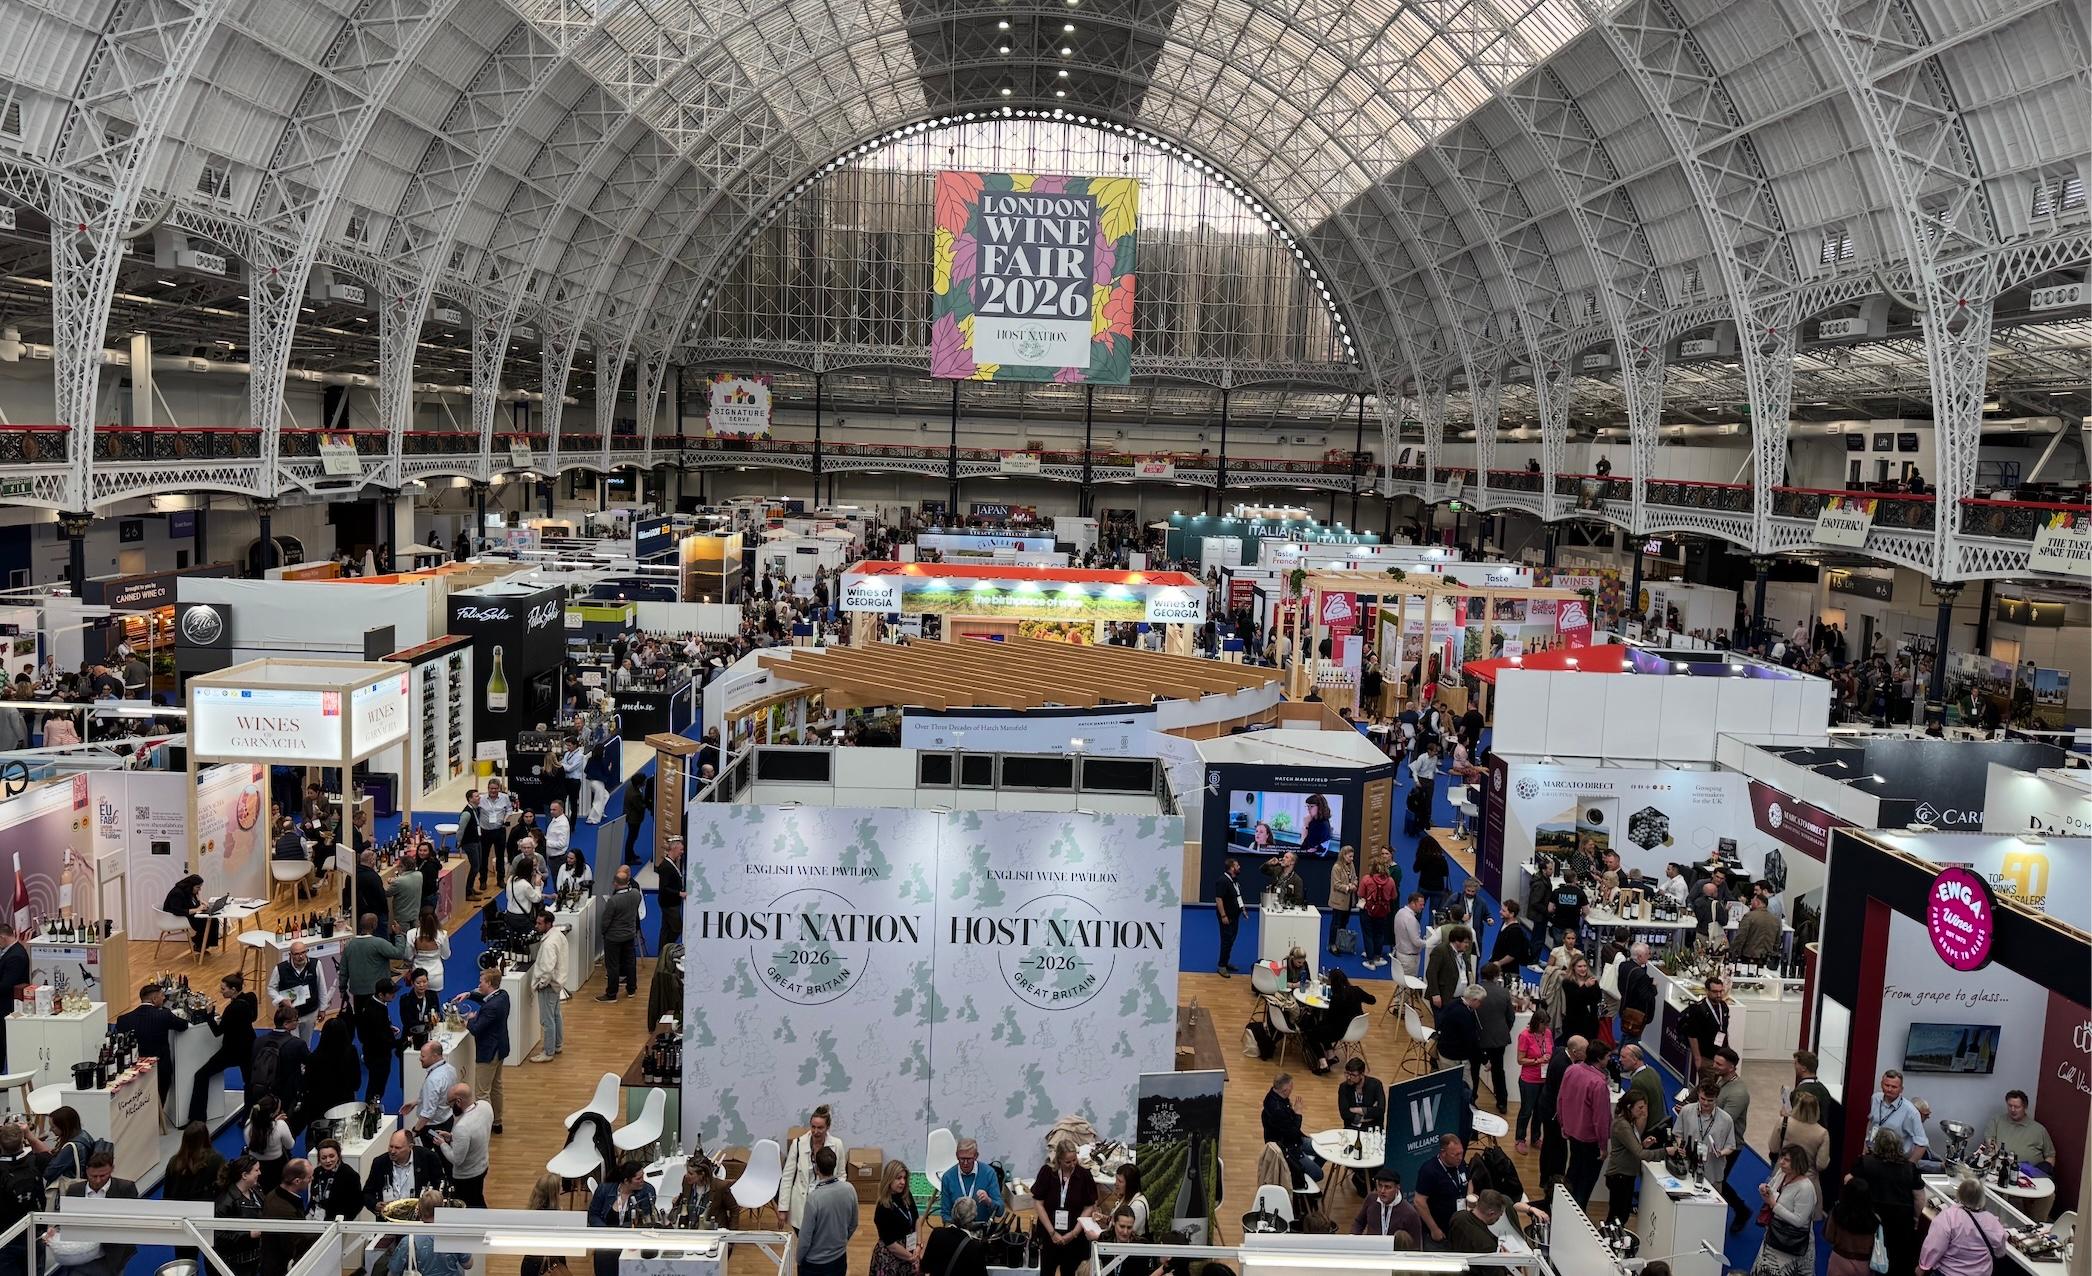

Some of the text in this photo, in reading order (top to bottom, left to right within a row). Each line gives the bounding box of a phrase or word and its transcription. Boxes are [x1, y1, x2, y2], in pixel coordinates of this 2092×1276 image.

[983, 196, 1090, 218] LONDON
[983, 215, 1090, 246] WINE
[981, 244, 1088, 279] FAIR
[979, 276, 1088, 318] 2026
[997, 330, 1068, 344] HOST NATION
[714, 408, 765, 418] SIGNATURE
[1878, 437, 1888, 447] Lift
[977, 504, 1009, 516] JAPAN
[1248, 525, 1288, 537] ITALIA
[1821, 518, 1864, 531] ESOTERICA
[2048, 537, 2066, 548] THE
[2038, 547, 2063, 558] SPACE
[1485, 573, 1509, 583] Taste
[1559, 577, 1595, 587] WINES
[125, 585, 140, 593] Brought
[881, 588, 893, 597] of
[116, 592, 141, 604] CANNED
[141, 589, 157, 600] WINE
[846, 597, 893, 607] GEORGIA
[974, 594, 991, 605] the
[992, 594, 1047, 608] birthplace
[1047, 597, 1058, 606] of
[1188, 600, 1200, 609] of
[1153, 609, 1200, 619] GEORGIA
[621, 701, 656, 712] medusa
[368, 703, 395, 724] WINES
[237, 716, 301, 733] WINES
[914, 723, 930, 731] Over
[931, 723, 948, 731] Three
[949, 723, 972, 732] Decades
[981, 724, 999, 732] Hatch
[1000, 723, 1028, 732] Mansfield
[231, 737, 306, 750] GARNACHA
[1543, 780, 1614, 790] MARCATO DIRECT
[100, 804, 112, 816] EU
[100, 815, 113, 825] FAB
[1784, 810, 1828, 838] MARCATO DIRECT
[746, 864, 880, 877] ENGLISH WINE PAVILION
[987, 870, 1119, 883] ENGLISH WINE PAVILION
[1989, 873, 2004, 883] TOP
[1938, 880, 1982, 920] EWGA
[1942, 907, 1974, 933] Wines
[700, 911, 920, 944] HOST NATION
[949, 916, 1165, 950] HOST NATION
[1938, 936, 1959, 959] GRAPE
[1960, 951, 1970, 961] TO
[789, 950, 829, 965] 2026
[1035, 956, 1076, 971] 2026
[767, 967, 851, 995] GREAT BRITAIN
[1014, 972, 1097, 1000] GREAT BRITAIN
[1884, 985, 1911, 999] From
[1911, 991, 1951, 1006] grape
[1956, 988, 1966, 1001] to
[1155, 1102, 1174, 1111] THE
[1409, 1093, 1442, 1137] W
[1407, 1135, 1440, 1151] WILLIAMS
